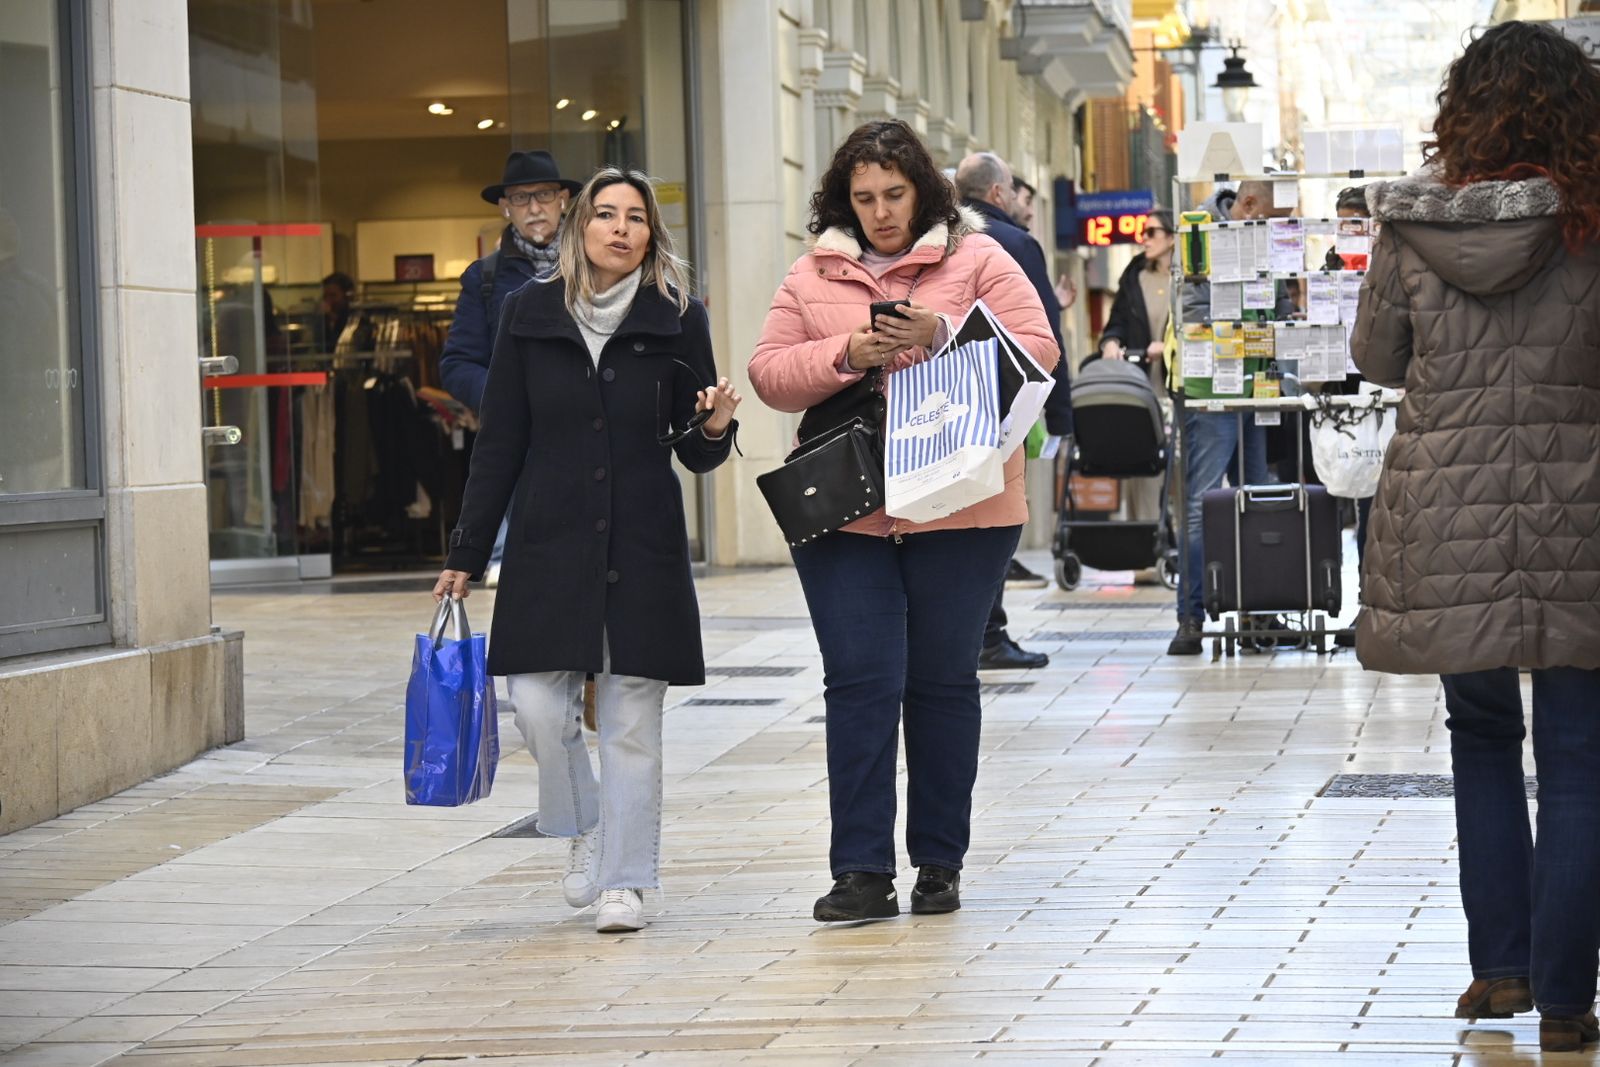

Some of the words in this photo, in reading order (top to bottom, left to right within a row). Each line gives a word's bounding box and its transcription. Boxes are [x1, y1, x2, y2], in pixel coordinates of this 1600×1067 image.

[1087, 215, 1113, 246] 12
[910, 402, 950, 427] CELESTE
[1337, 447, 1349, 459] La
